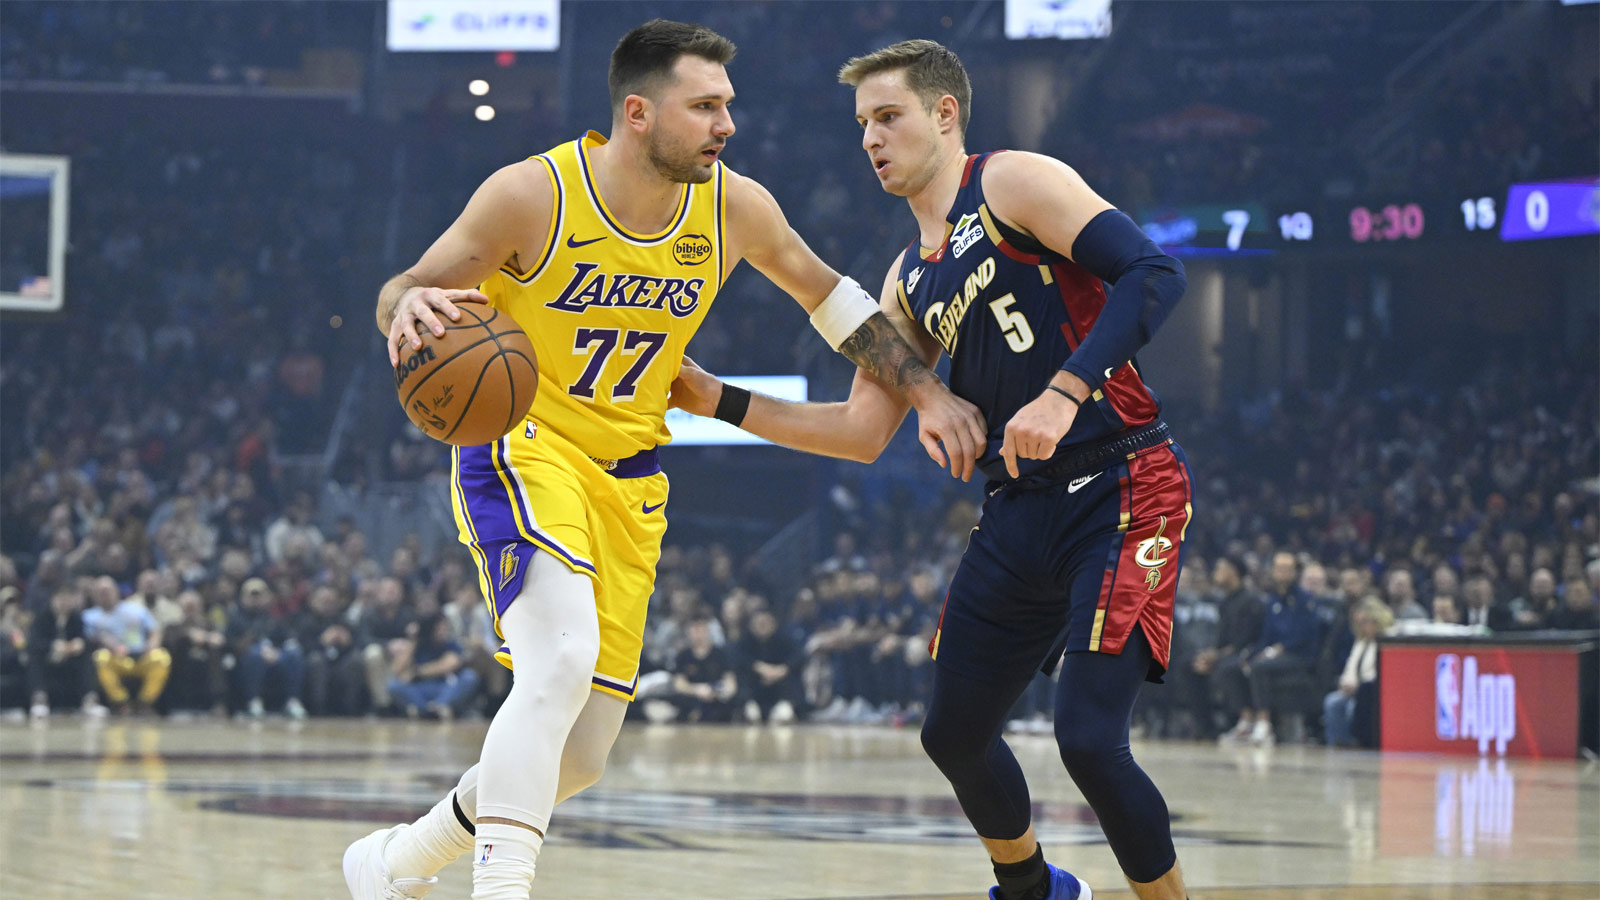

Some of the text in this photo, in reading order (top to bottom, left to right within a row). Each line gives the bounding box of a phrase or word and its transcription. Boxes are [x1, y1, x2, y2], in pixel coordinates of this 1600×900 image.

[676, 242, 710, 257] bibigo
[953, 227, 982, 255] CLIFFS
[1221, 209, 1250, 251] 7
[1350, 203, 1424, 242] 9:30
[1461, 196, 1497, 231] 15
[1525, 189, 1550, 233] 0
[544, 262, 706, 318] LAKERS
[924, 256, 996, 359] CLEVELAND
[988, 292, 1034, 353] 5
[567, 326, 670, 404] 77
[1461, 655, 1516, 753] App
